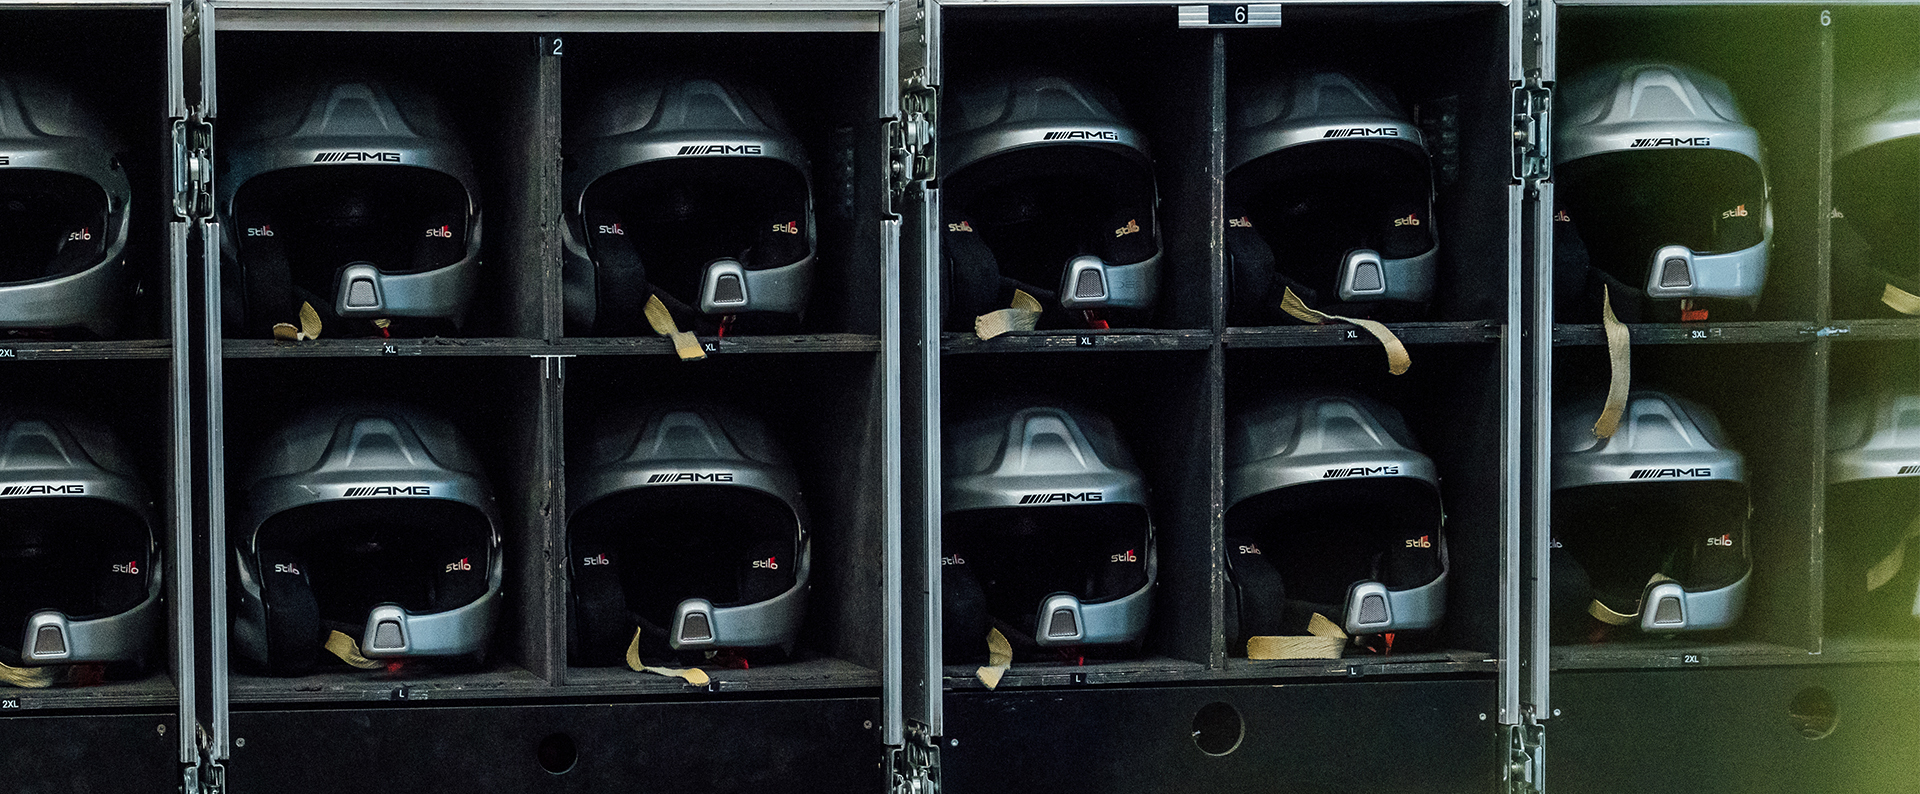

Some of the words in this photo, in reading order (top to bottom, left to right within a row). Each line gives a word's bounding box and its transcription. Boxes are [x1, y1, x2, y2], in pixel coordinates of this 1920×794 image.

[1235, 7, 1246, 22] 6
[1820, 10, 1831, 26] 6
[553, 39, 562, 55] 2
[1347, 330, 1358, 338] XL
[1692, 330, 1707, 339] 3XL
[1081, 337, 1092, 345] XL
[385, 346, 396, 354] XL
[705, 343, 716, 351] XL
[0, 349, 15, 358] 2XL
[1684, 654, 1699, 663] 2XL
[1351, 666, 1356, 675] L
[1076, 675, 1081, 683] L
[399, 689, 404, 698] L
[2, 699, 19, 708] 2XL
